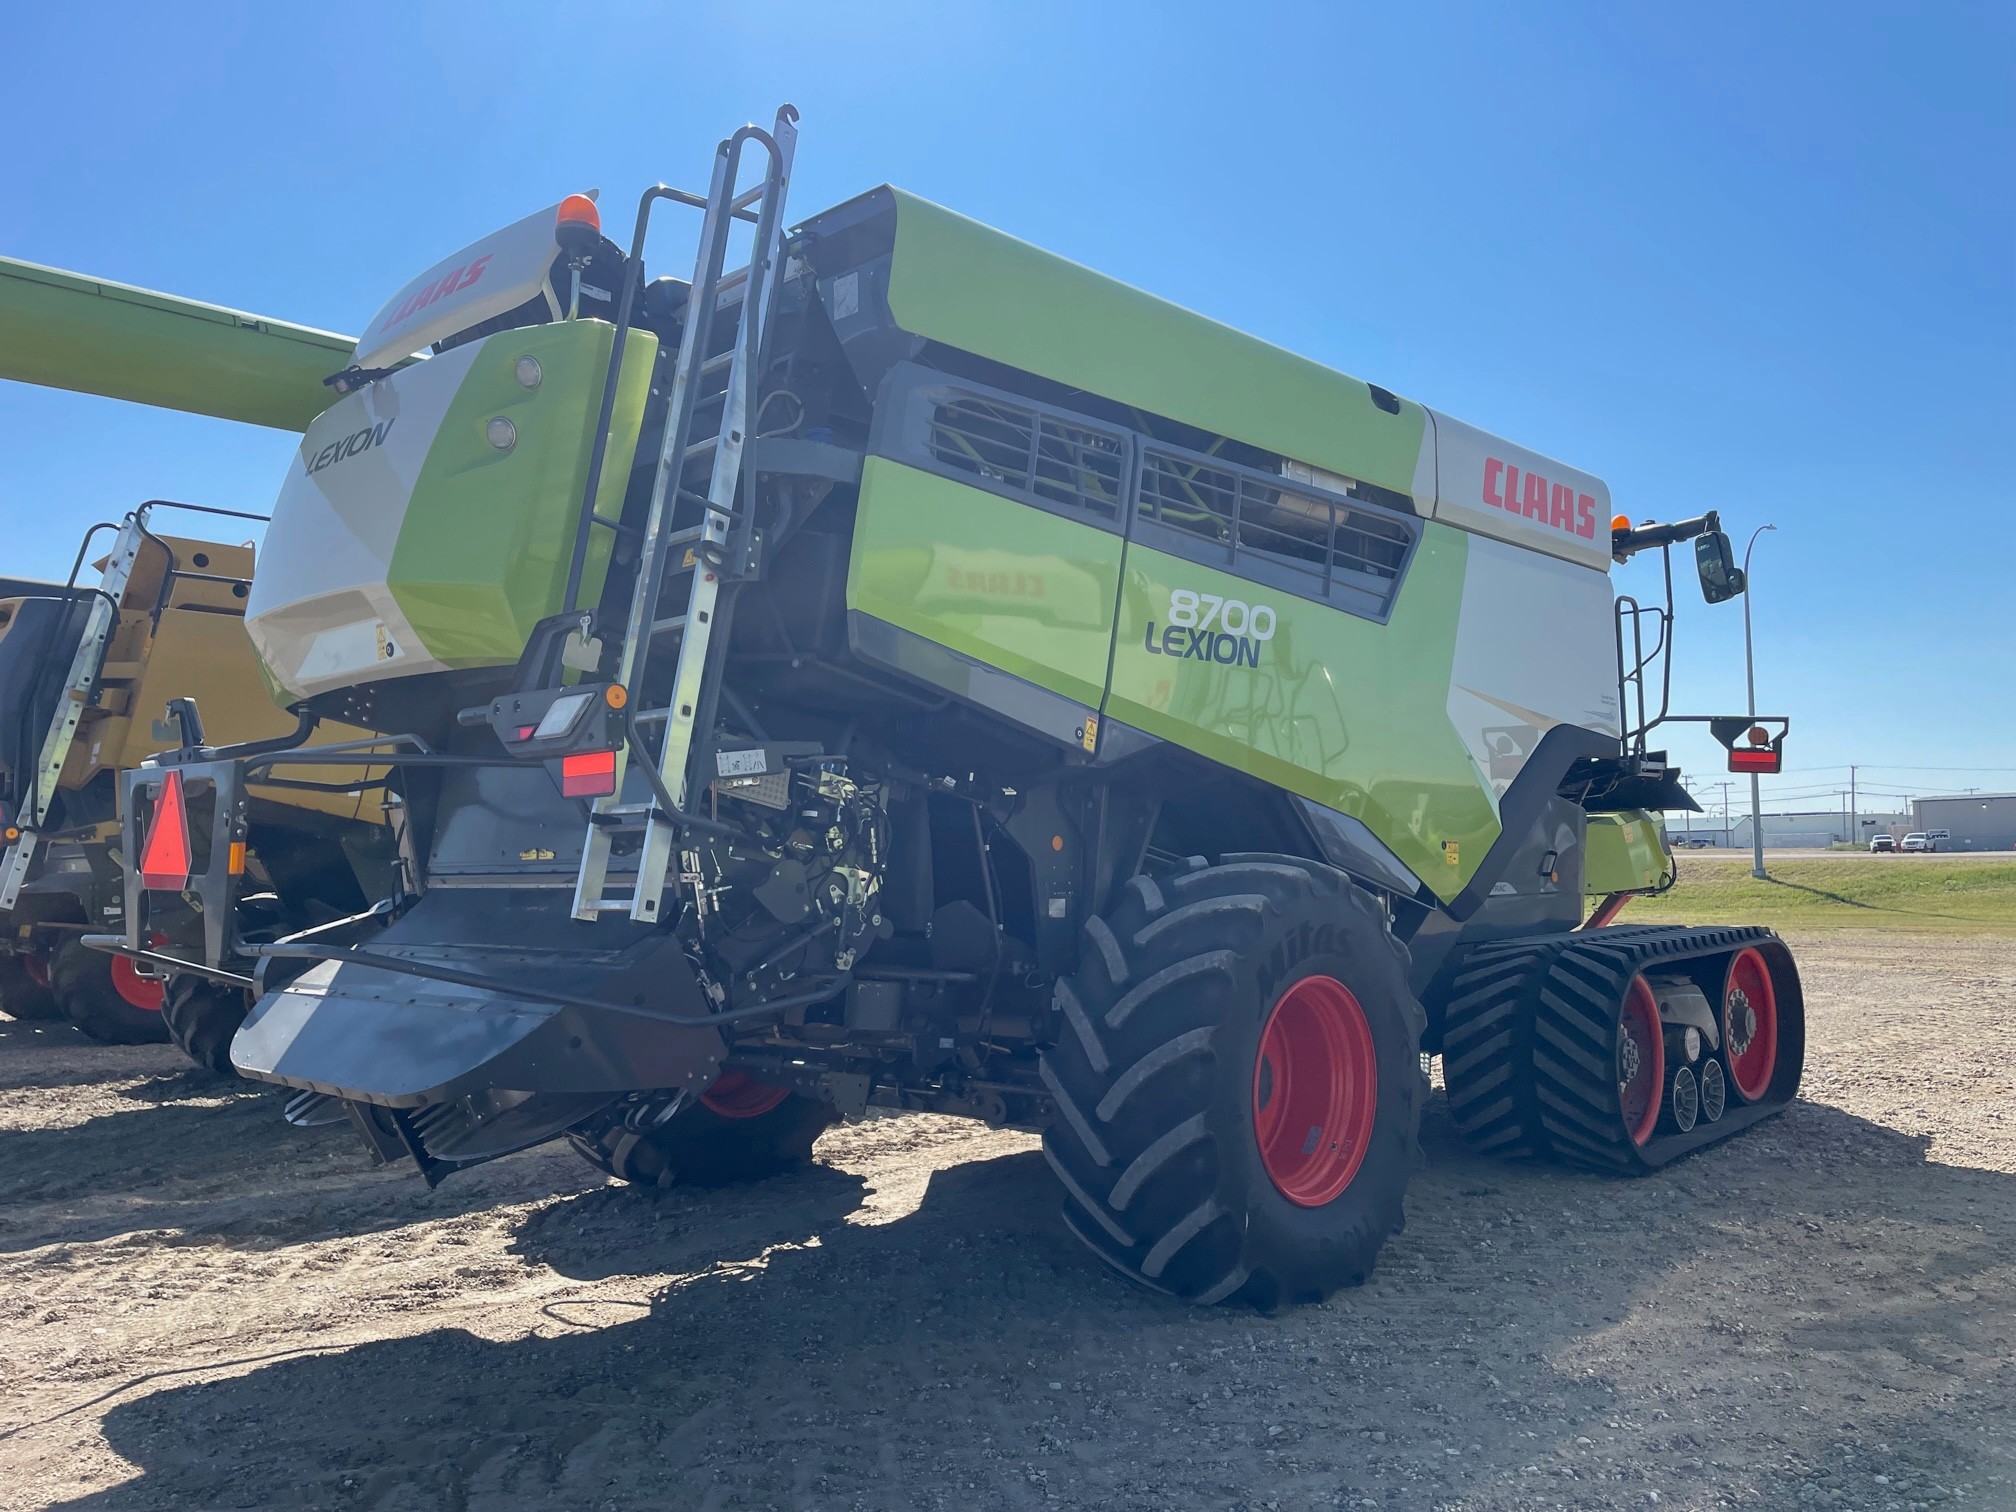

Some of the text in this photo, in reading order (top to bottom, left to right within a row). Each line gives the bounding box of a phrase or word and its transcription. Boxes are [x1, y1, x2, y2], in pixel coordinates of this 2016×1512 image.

[379, 253, 494, 334] CLAAS
[305, 416, 396, 477] LEXION
[1483, 456, 1596, 540] CLAAS
[1145, 621, 1261, 669] LEXION
[1168, 588, 1277, 641] 8700
[1256, 919, 1356, 1021] Mitas
